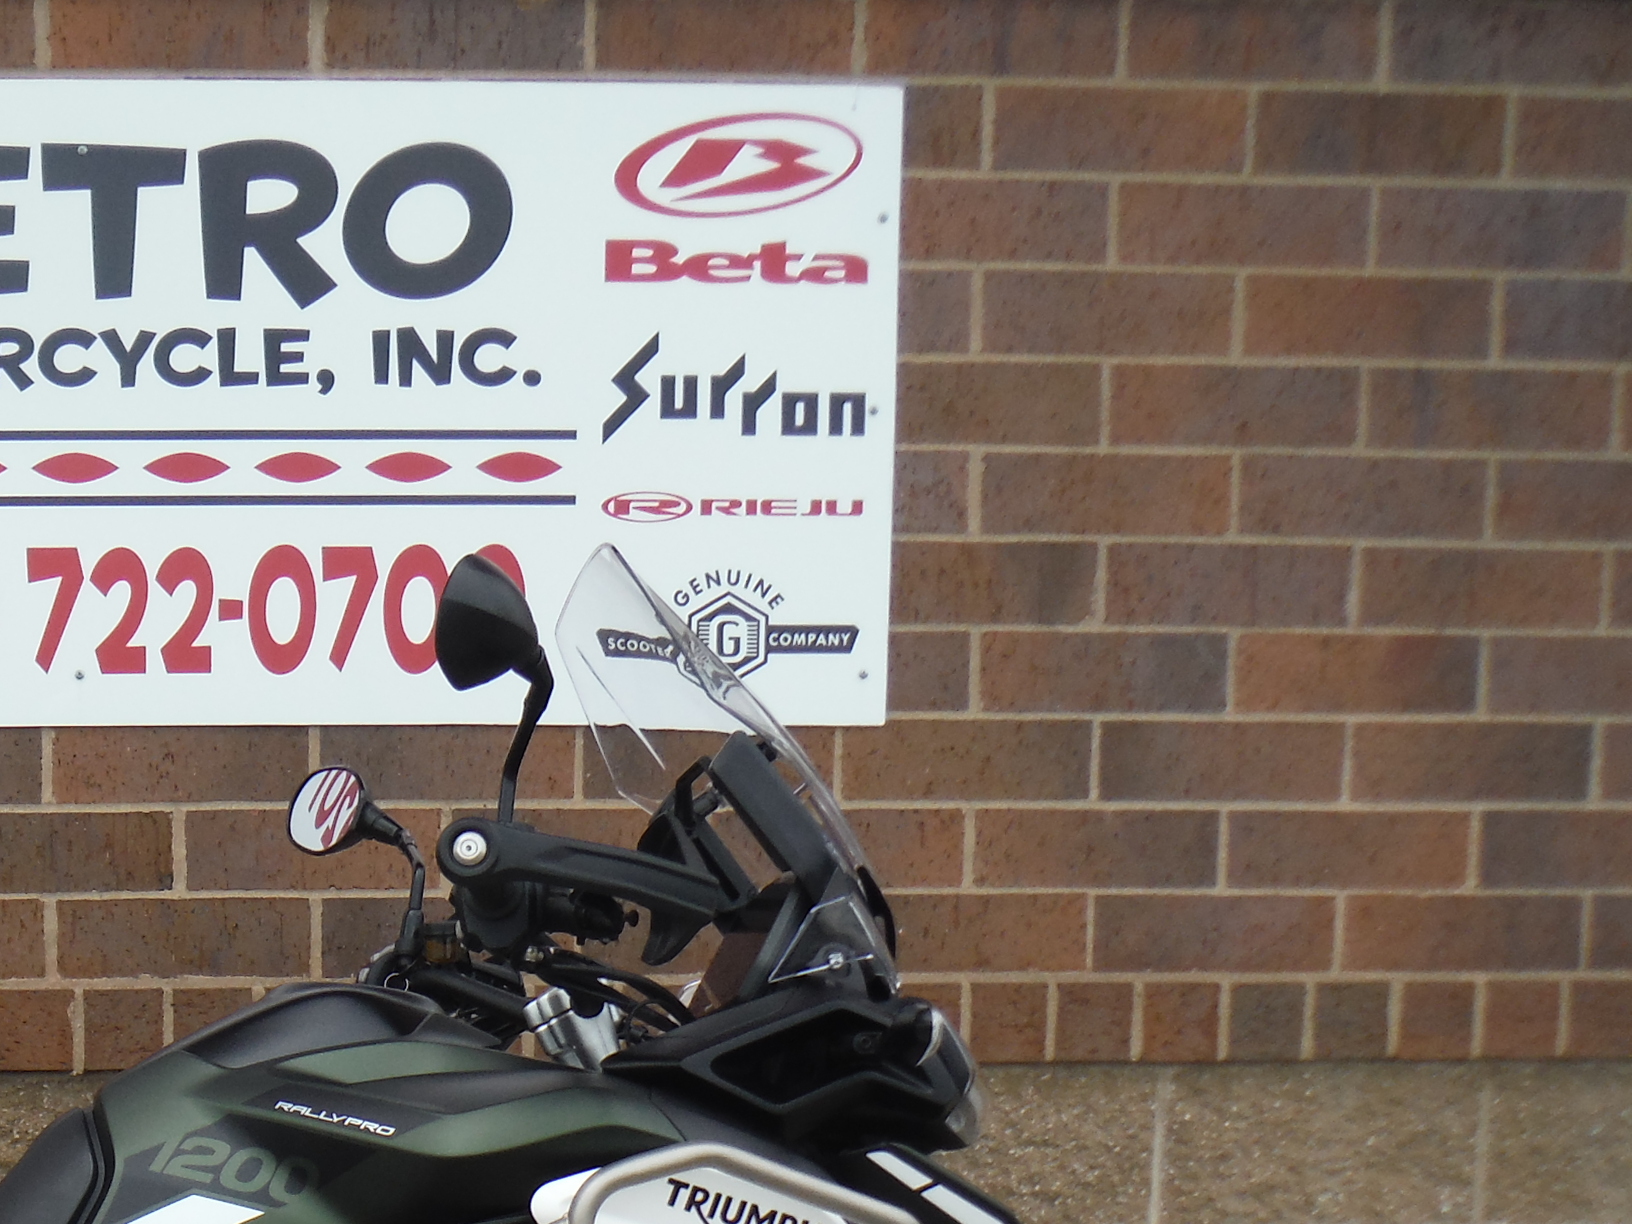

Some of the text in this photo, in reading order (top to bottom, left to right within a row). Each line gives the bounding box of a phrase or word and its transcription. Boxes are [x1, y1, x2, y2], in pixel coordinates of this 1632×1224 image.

[605, 240, 868, 284] Beta
[372, 327, 541, 387] INC.
[701, 500, 863, 515] RIEJU
[27, 544, 526, 676] 722-070
[673, 568, 785, 611] GENUINE
[768, 631, 851, 648] COMPANY
[274, 1100, 397, 1138] RALLYPRO
[149, 1136, 320, 1202] 1200
